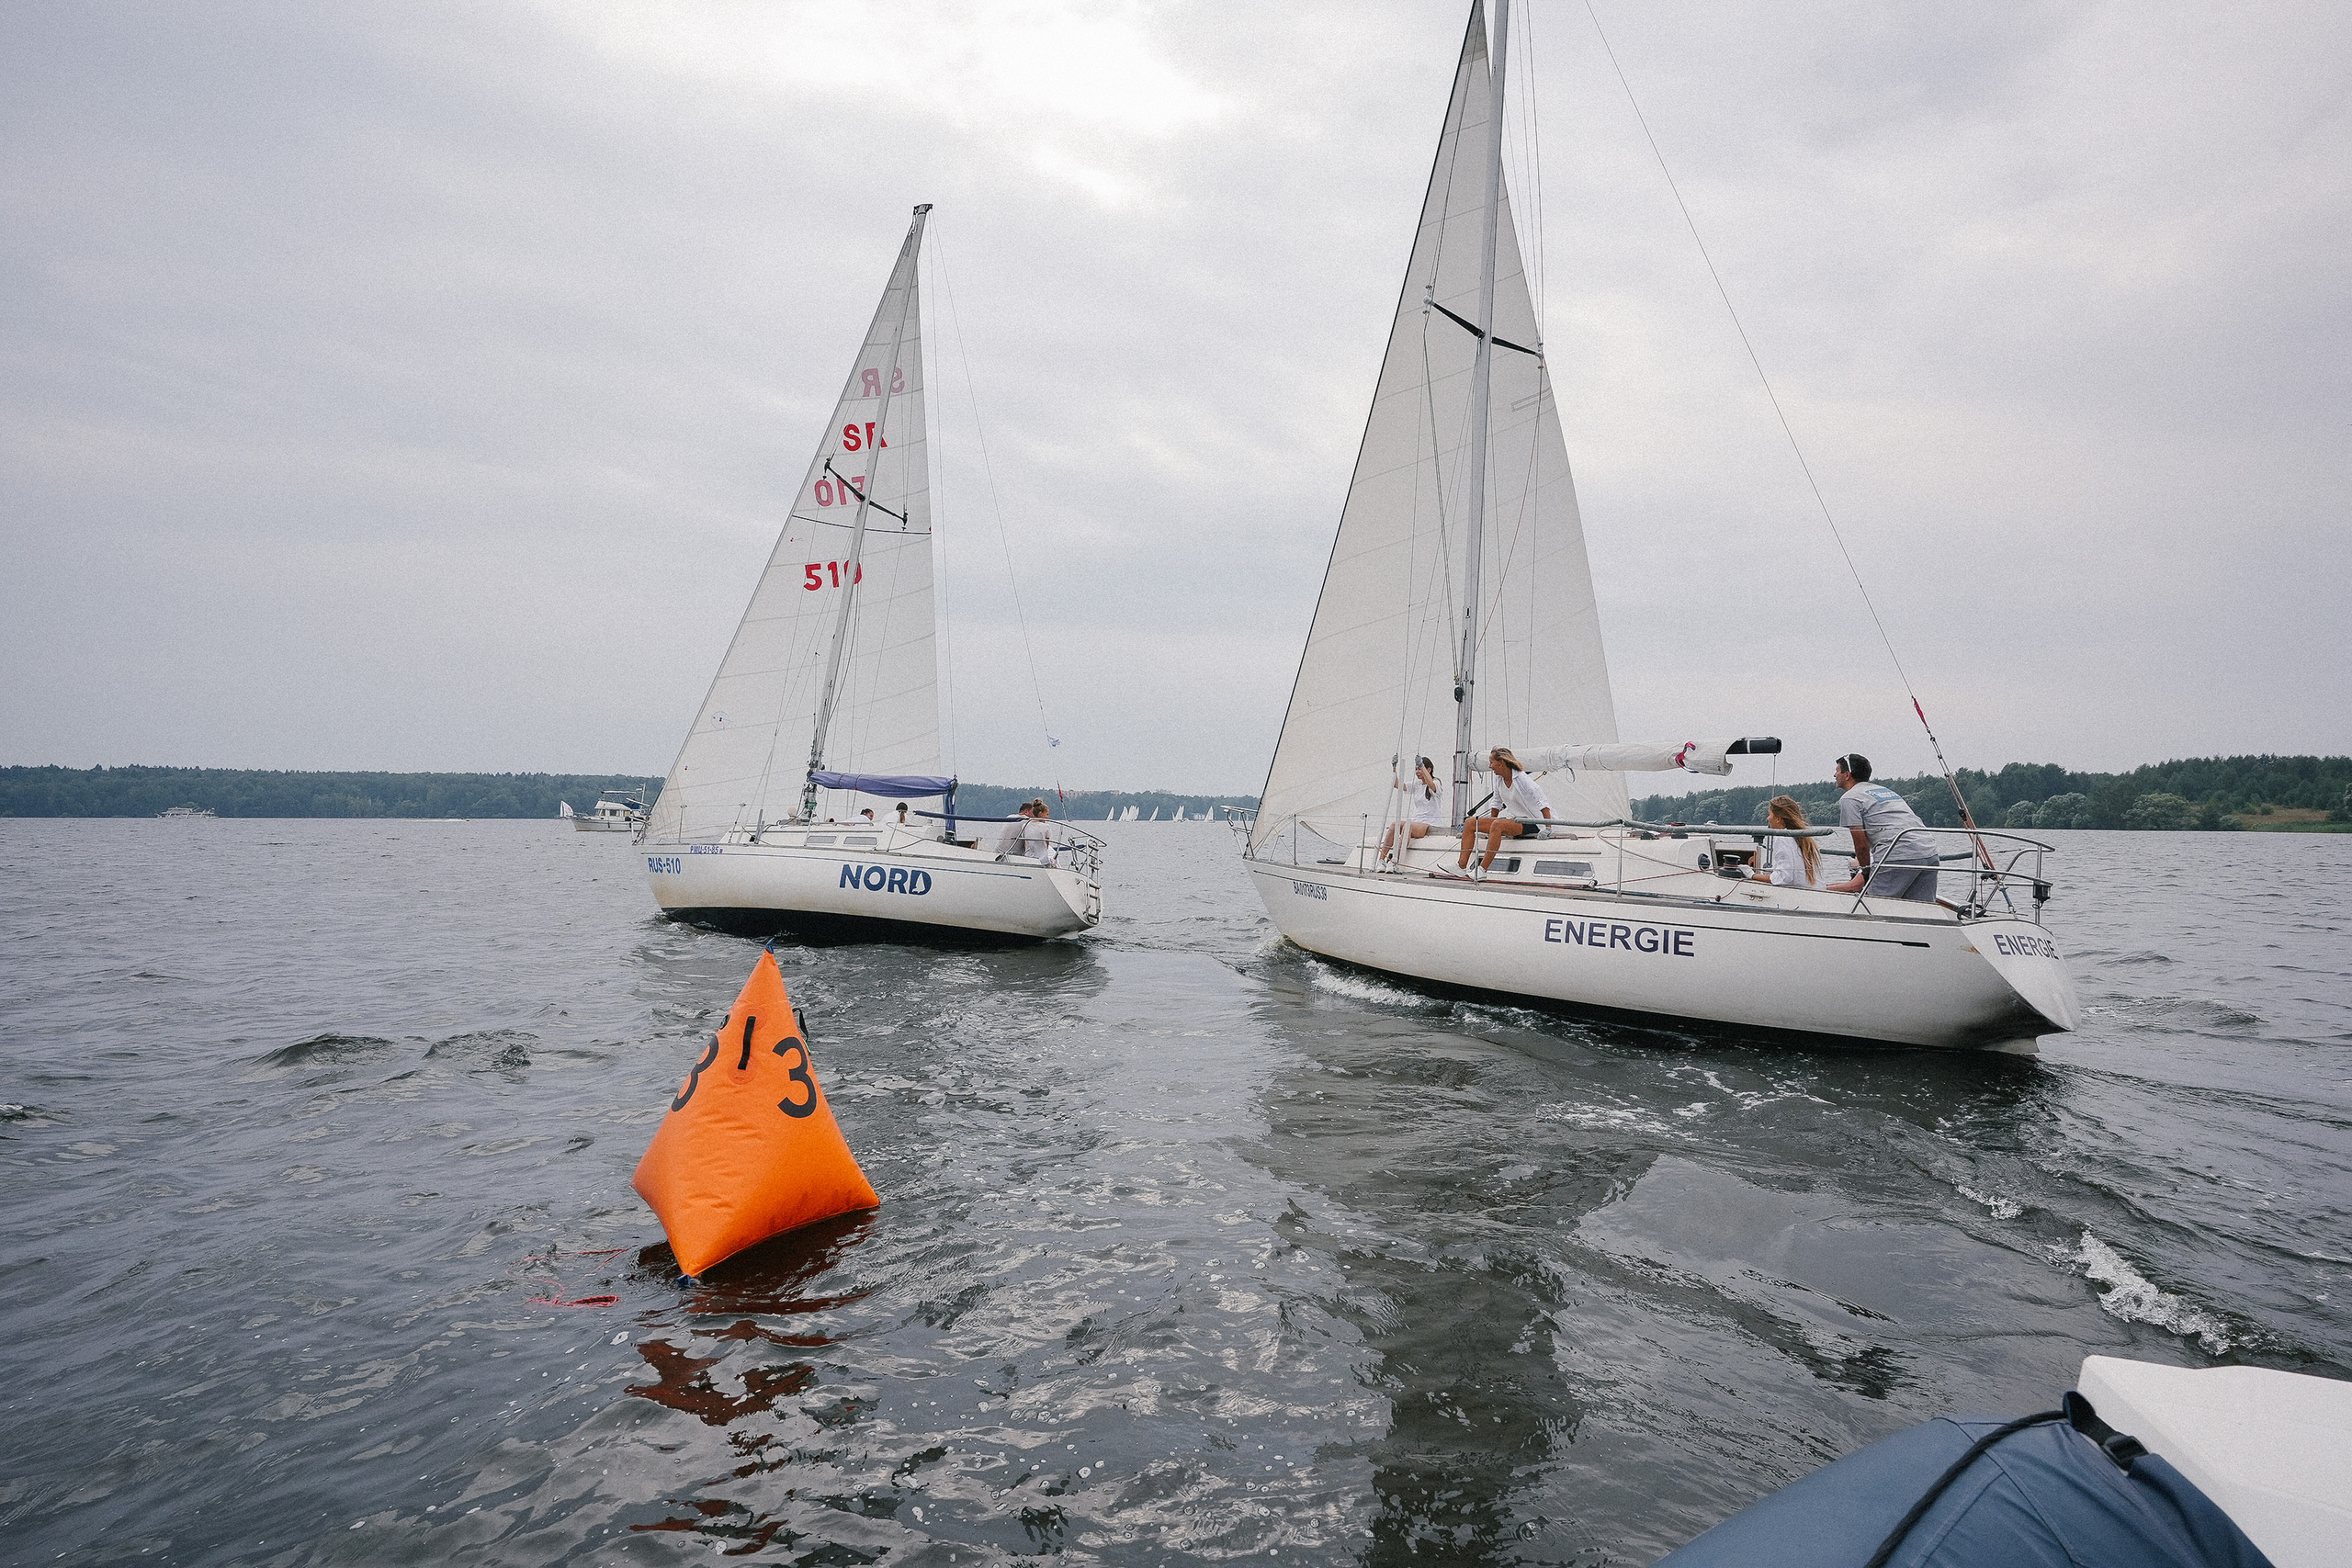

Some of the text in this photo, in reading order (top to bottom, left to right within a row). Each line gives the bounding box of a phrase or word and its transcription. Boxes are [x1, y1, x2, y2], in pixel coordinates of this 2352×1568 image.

[648, 857, 681, 874] RUS-510
[839, 863, 933, 896] NORD
[1544, 919, 1695, 957] ENERGIE
[1993, 934, 2060, 961] ENERGIE
[772, 1036, 818, 1119] 3
